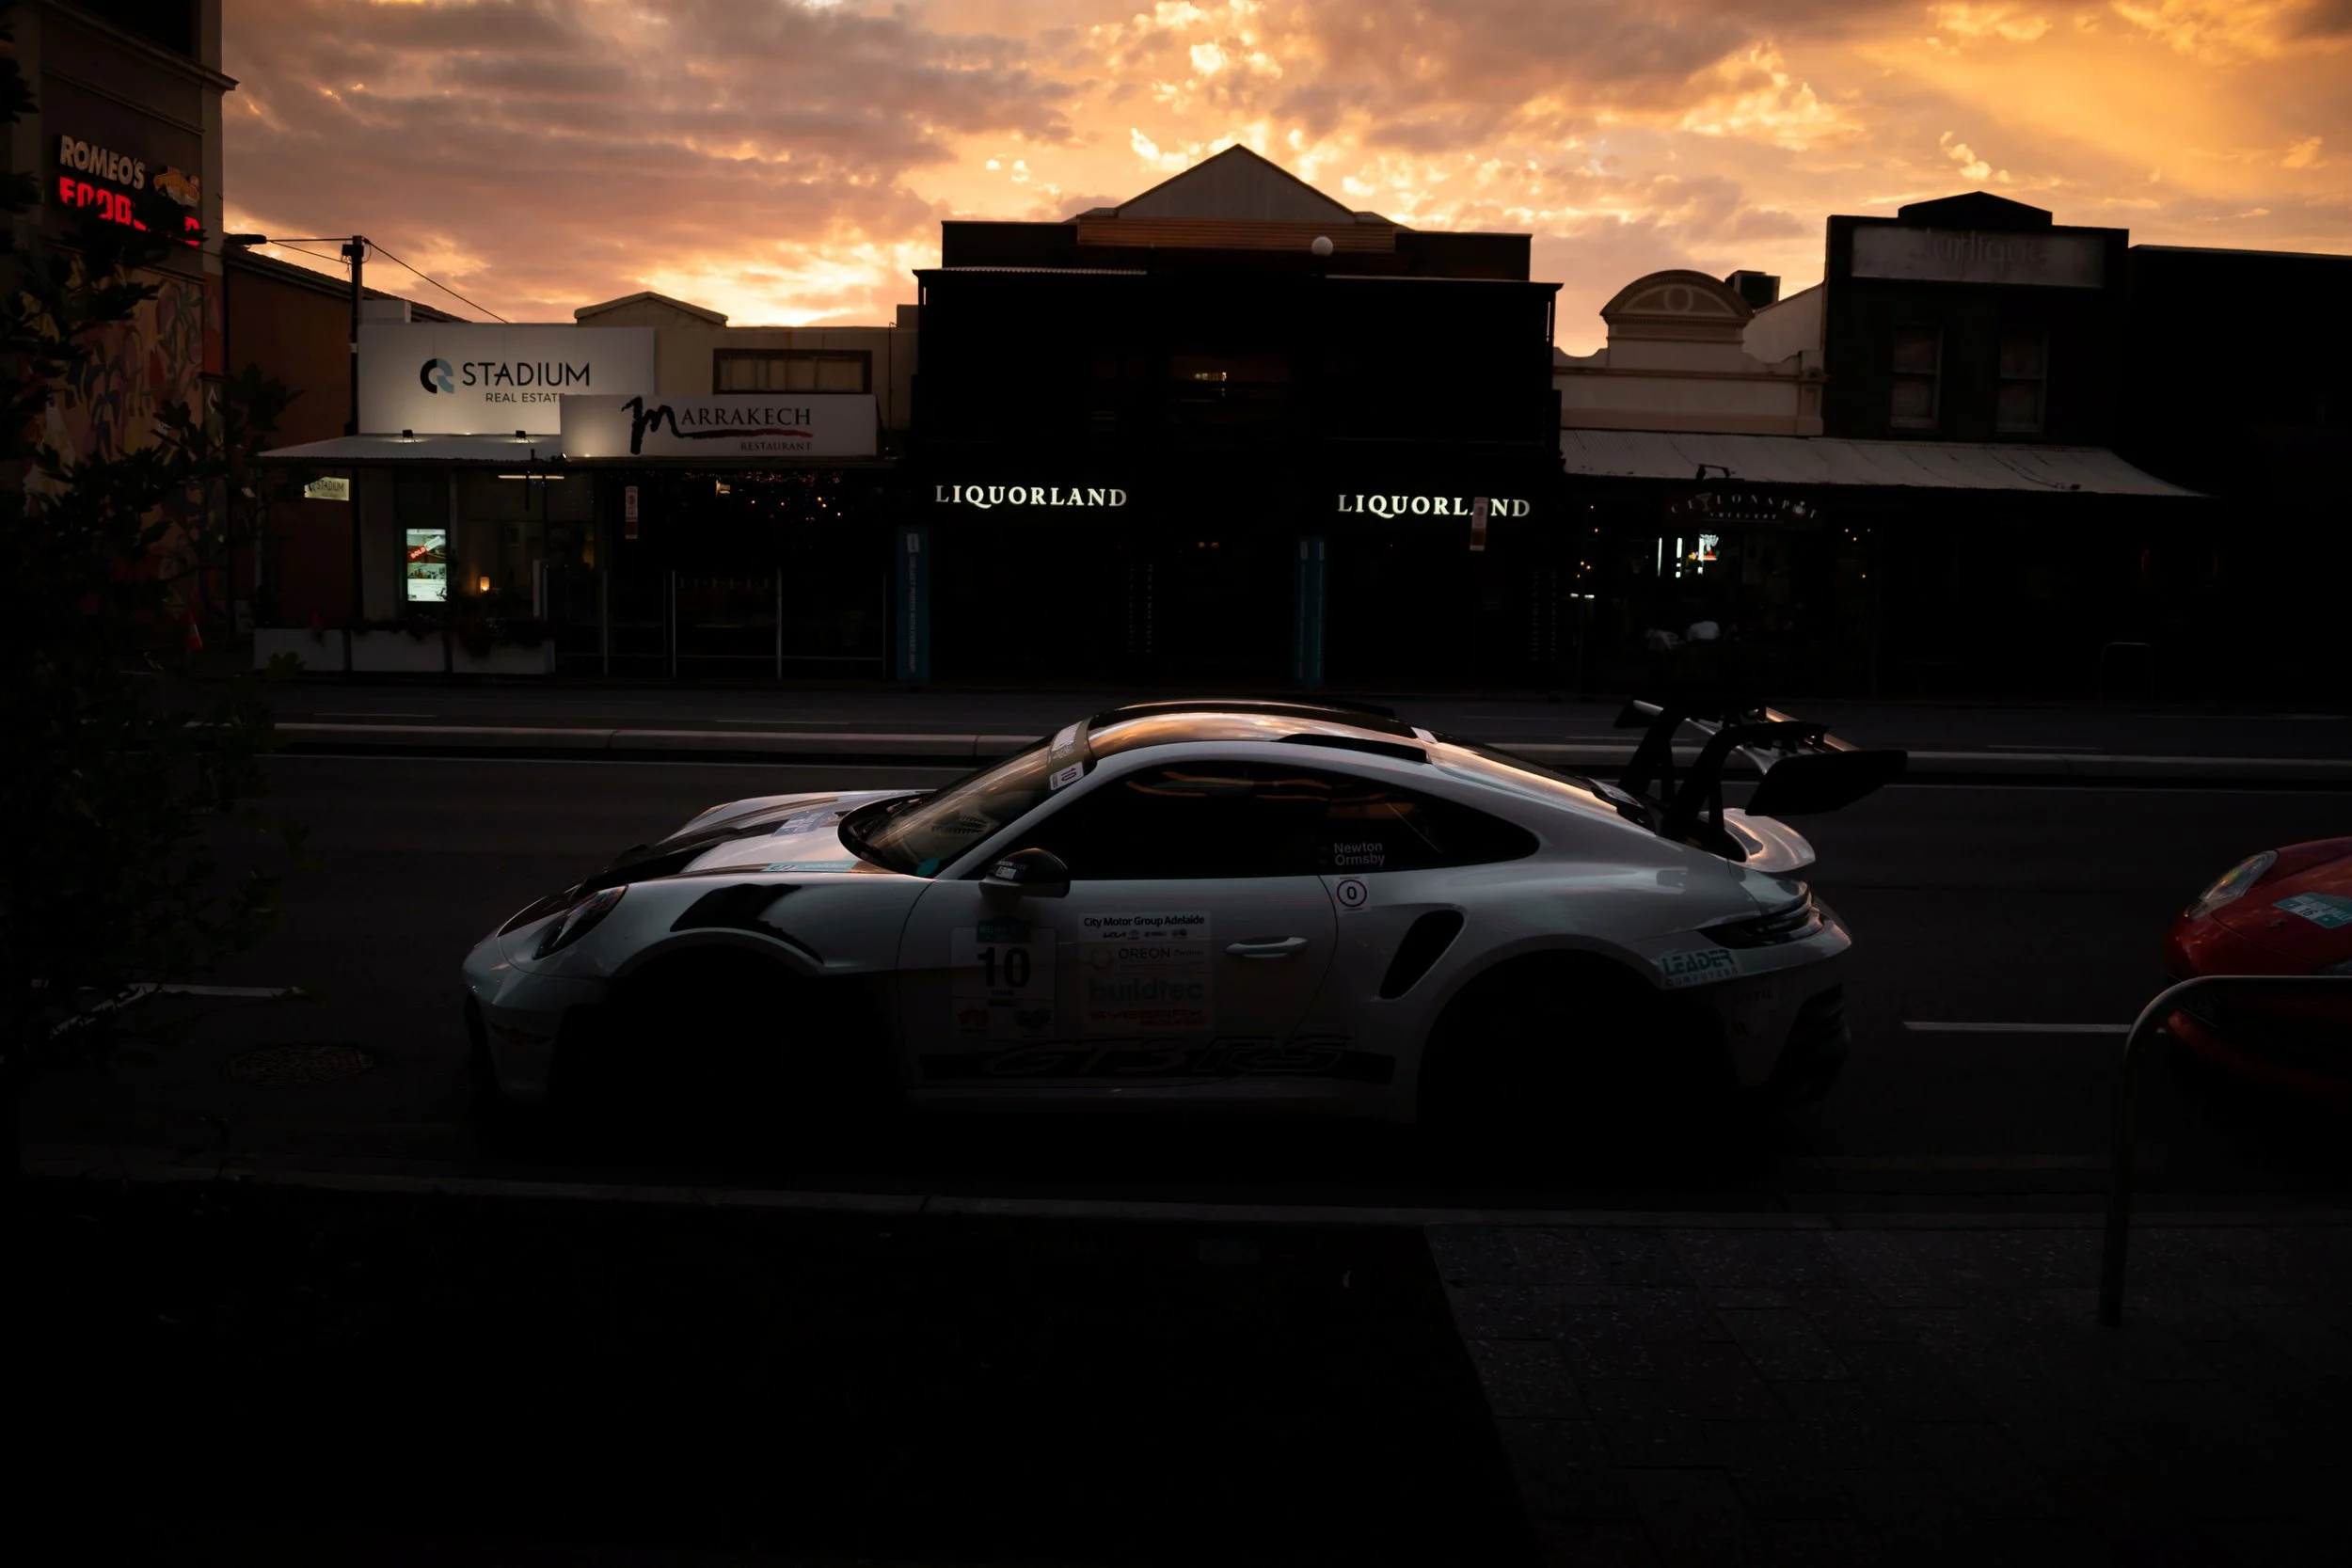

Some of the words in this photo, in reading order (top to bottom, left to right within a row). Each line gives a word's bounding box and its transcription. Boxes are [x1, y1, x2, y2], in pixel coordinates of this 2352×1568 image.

[59, 135, 147, 190] ROMEO'S
[462, 361, 590, 387] STADIUM
[485, 392, 517, 403] REAL
[522, 392, 564, 403] ESTAT
[621, 396, 811, 454] MARRAKECH
[741, 441, 812, 451] RESTAURANT
[934, 484, 1128, 509] LIQUORLAND
[1337, 494, 1532, 519] LIQUORLND
[410, 546, 426, 559] SOLD
[1060, 767, 1077, 782] 10
[1333, 842, 1383, 854] Newton
[1334, 853, 1386, 866] Ormsby
[1084, 917, 1102, 928] City
[1104, 917, 1132, 927] Motor
[1134, 916, 1163, 927] Group
[1165, 915, 1204, 926] Adelaide
[1118, 947, 1171, 959] OREON
[1661, 949, 1734, 975] LEADER
[977, 946, 1030, 988] 10
[1665, 967, 1739, 987] COMPUTERS
[1089, 977, 1204, 1002] buildtec
